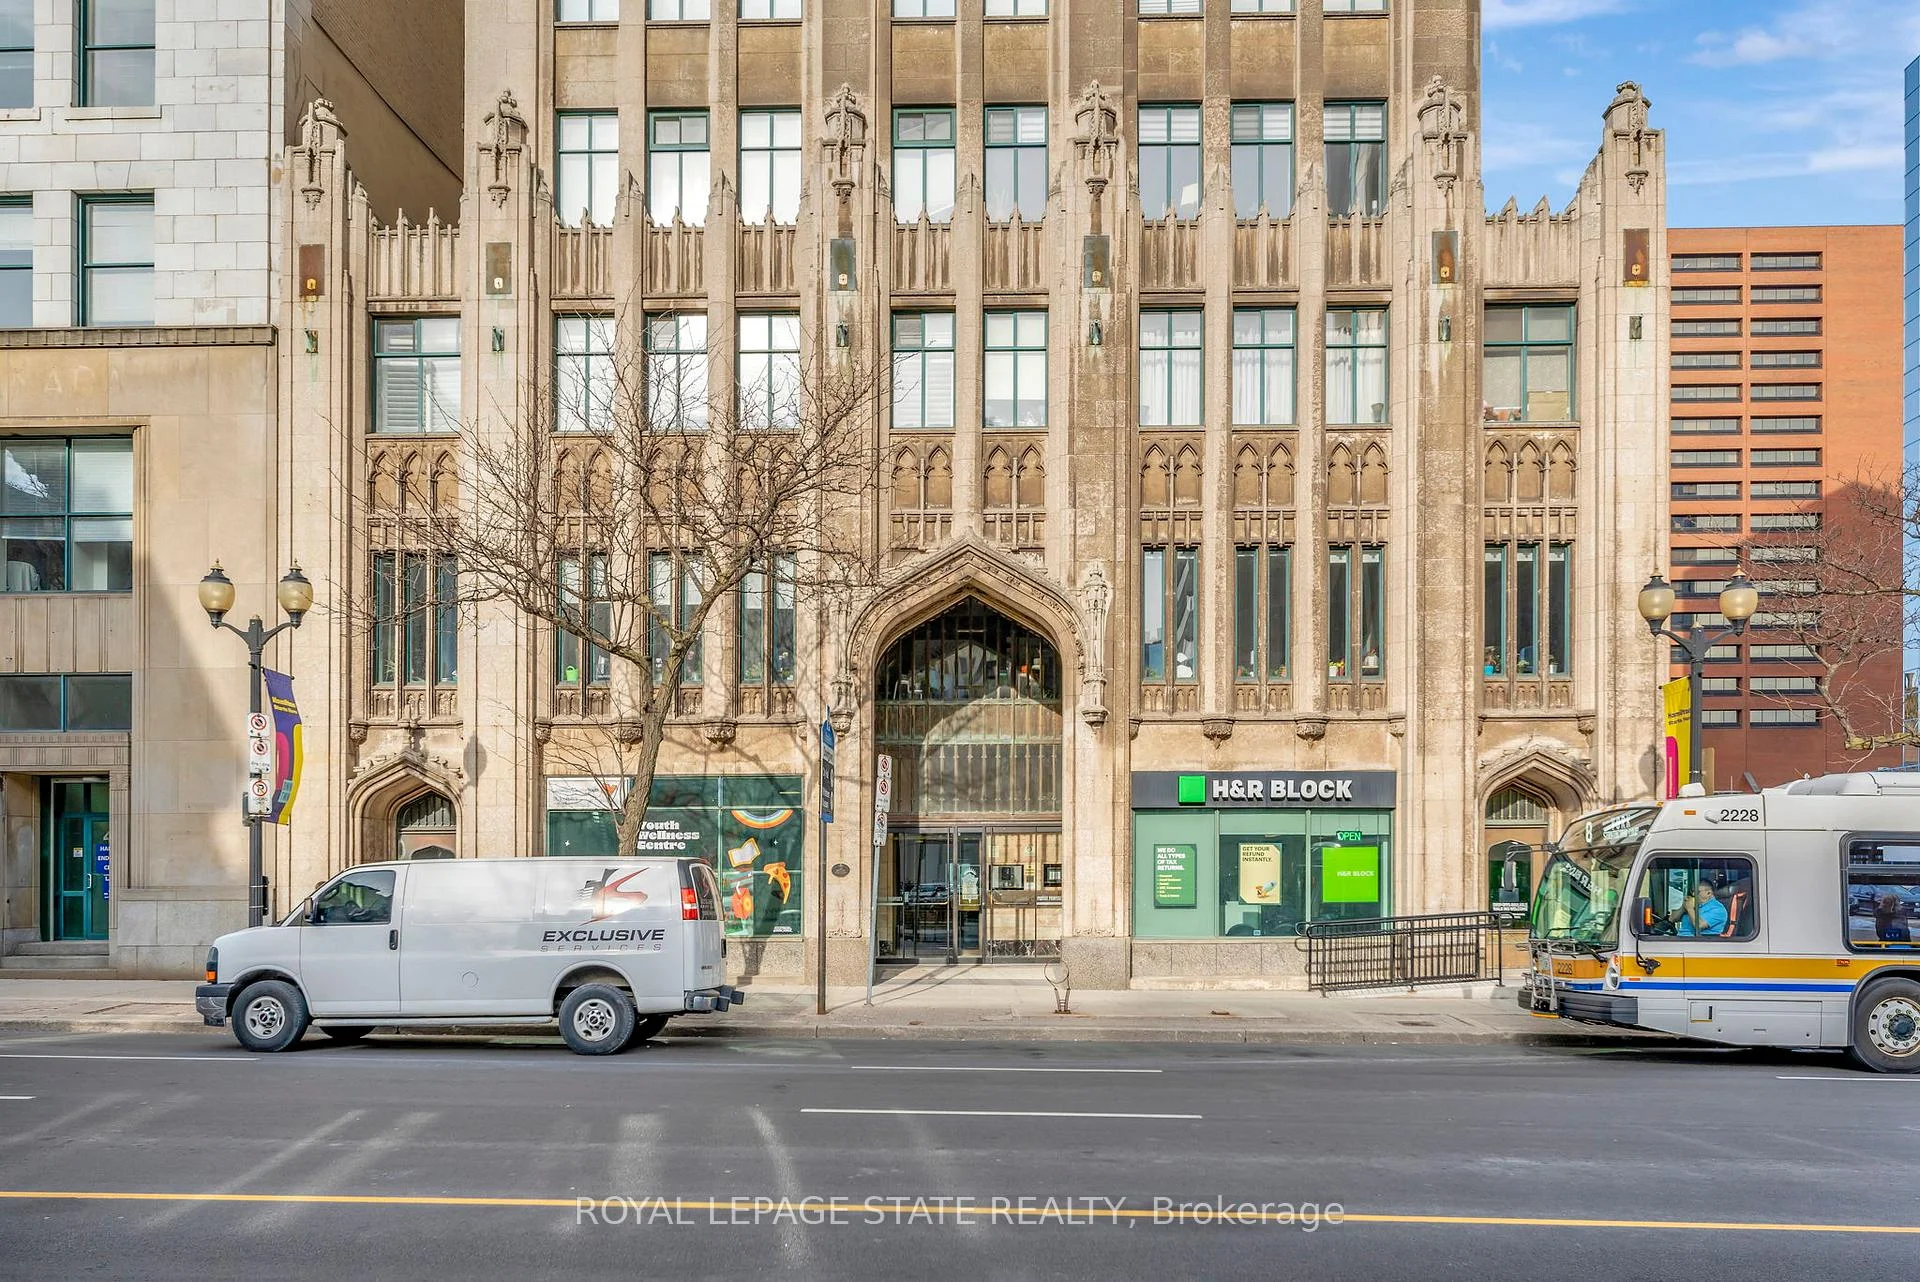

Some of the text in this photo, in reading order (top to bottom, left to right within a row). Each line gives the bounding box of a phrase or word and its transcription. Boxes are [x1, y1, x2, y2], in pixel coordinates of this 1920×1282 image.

[1212, 780, 1353, 799] H&R BLOCK
[1720, 809, 1759, 822] 2228
[640, 820, 680, 831] Youth
[638, 830, 701, 840] Wellness
[1337, 831, 1362, 841] OPEN
[1585, 821, 1593, 843] 8
[637, 840, 687, 850] Centre
[542, 929, 666, 942] EXCLUSIVE
[539, 943, 662, 952] SERVICES
